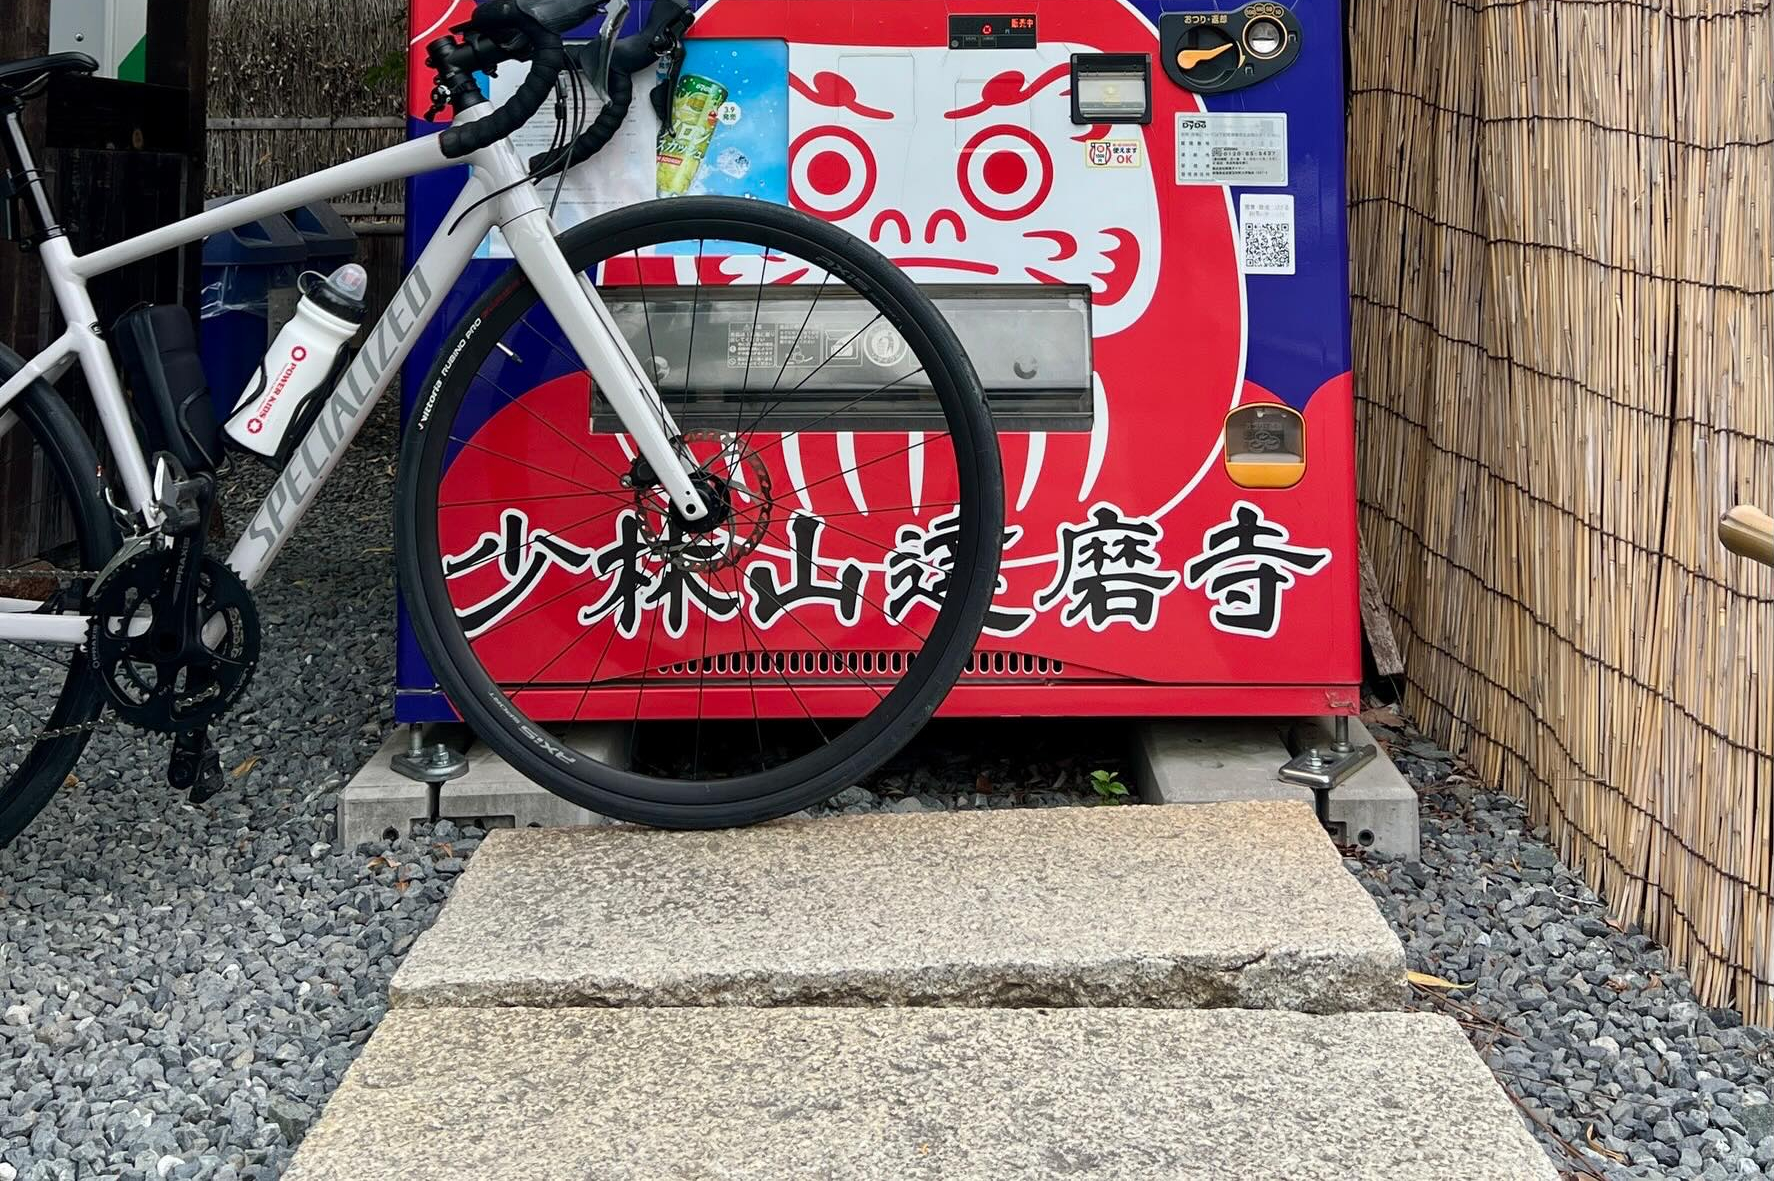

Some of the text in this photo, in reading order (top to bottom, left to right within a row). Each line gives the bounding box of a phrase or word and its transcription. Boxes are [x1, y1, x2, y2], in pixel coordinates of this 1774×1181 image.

[1011, 18, 1034, 28] 販売中
[1182, 120, 1207, 130] DyDo
[1116, 155, 1133, 164] OK
[441, 338, 467, 377] RUBINO
[465, 317, 482, 340] PRO
[273, 362, 297, 396] POWER
[249, 265, 433, 563] SPECIALIZED
[259, 397, 277, 419] KIDS
[440, 502, 1333, 640] 少林山達磨寺
